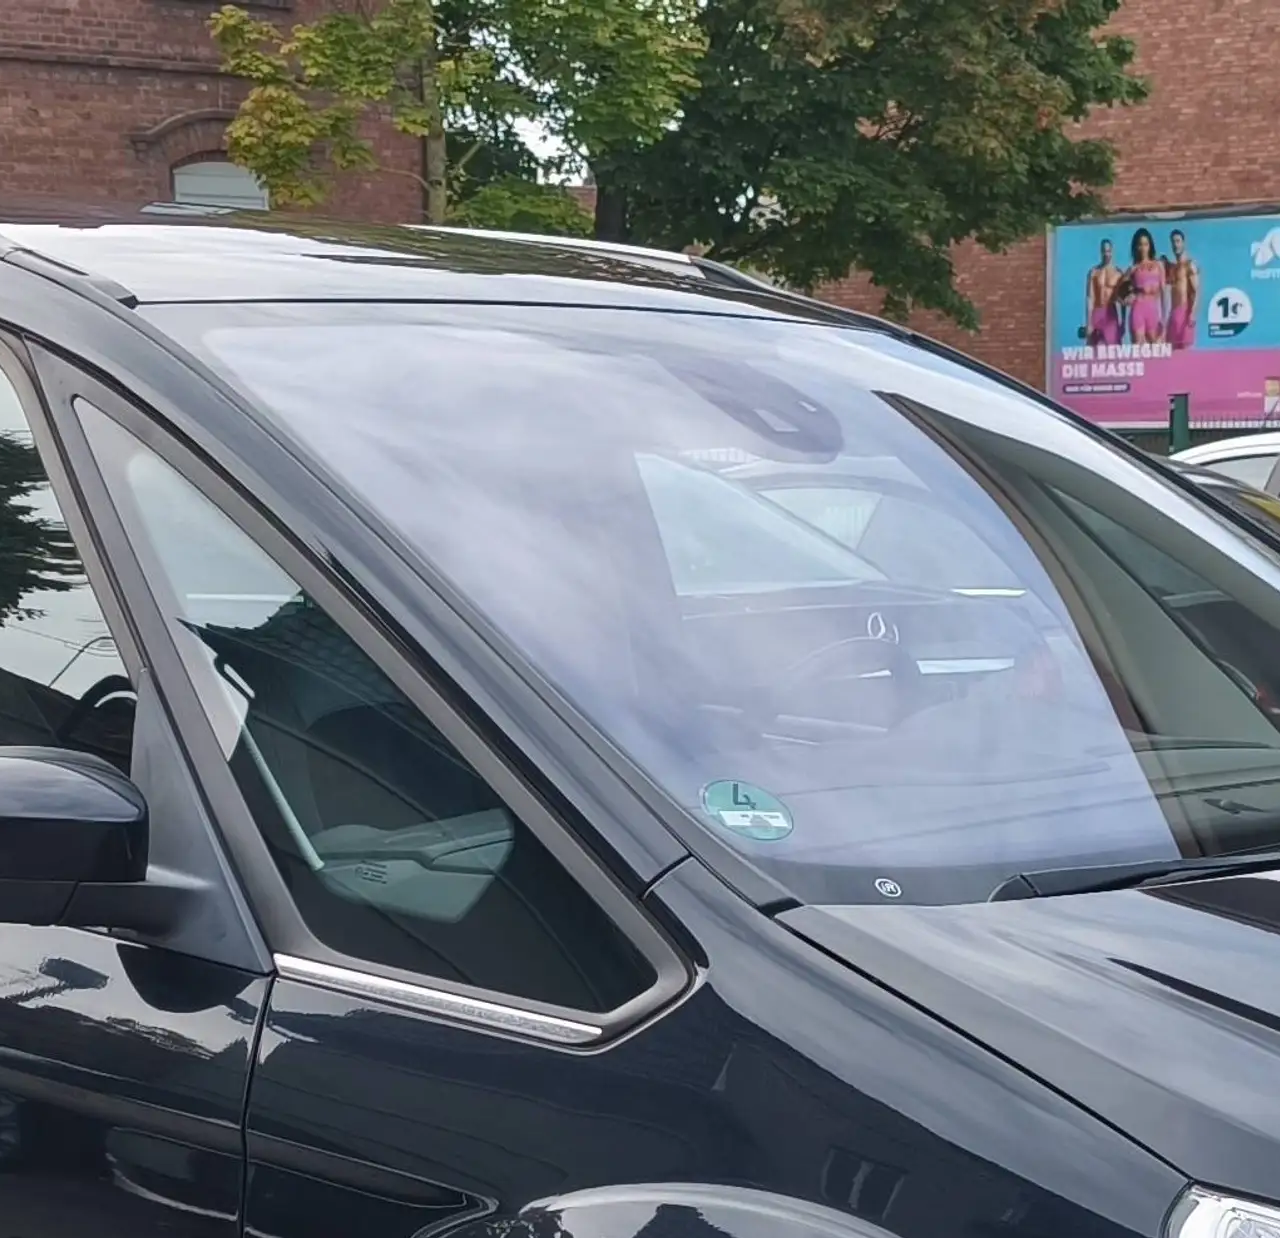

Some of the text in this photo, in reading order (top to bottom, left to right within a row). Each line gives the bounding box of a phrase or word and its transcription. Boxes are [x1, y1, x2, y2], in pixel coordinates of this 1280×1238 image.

[1061, 342, 1173, 360] WIR BEWEGEN
[1061, 361, 1145, 378] DIE MASSE
[732, 783, 757, 809] 4
